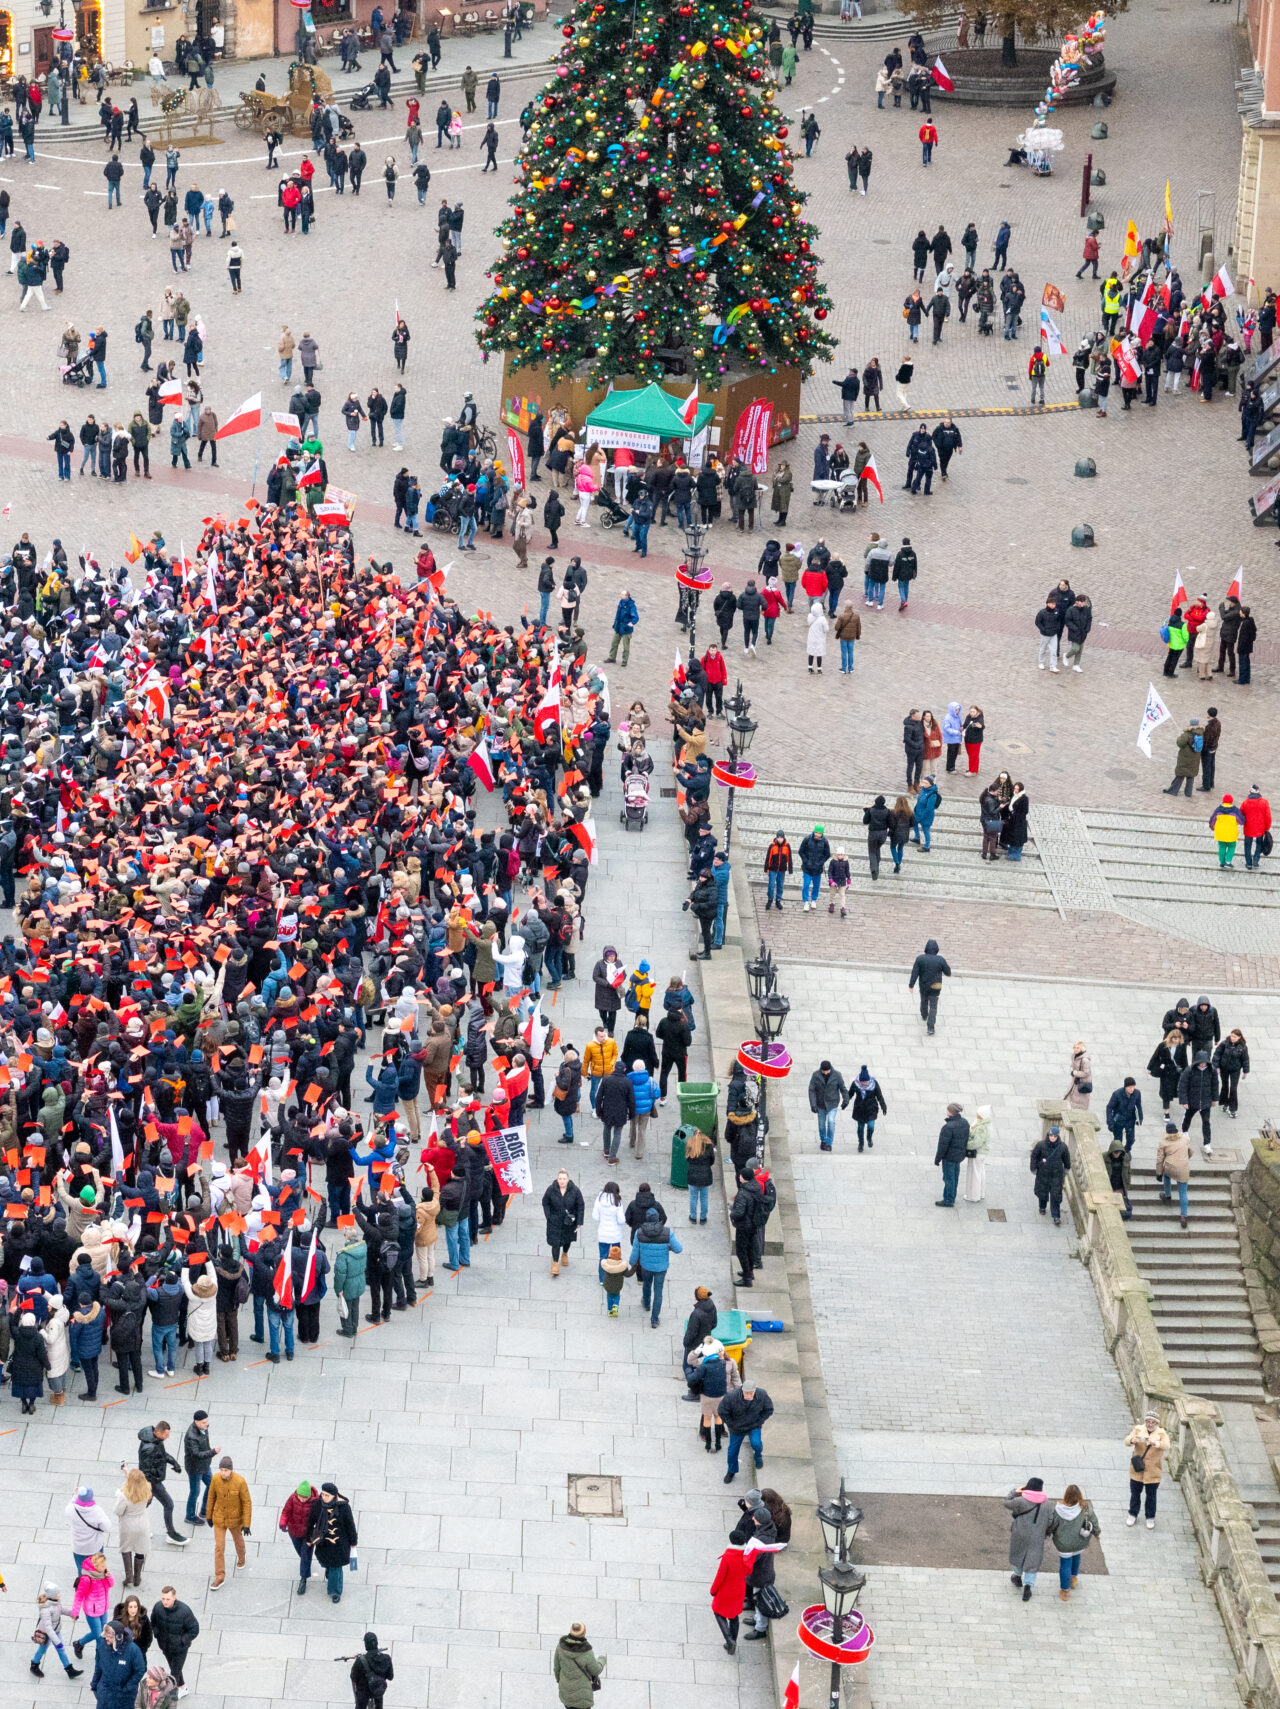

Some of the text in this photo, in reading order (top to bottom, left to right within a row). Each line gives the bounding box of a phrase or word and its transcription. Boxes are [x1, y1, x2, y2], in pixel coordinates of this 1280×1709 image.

[591, 428, 608, 436] STOP
[494, 1135, 511, 1162] HONOR
[504, 1132, 525, 1159] BÓG
